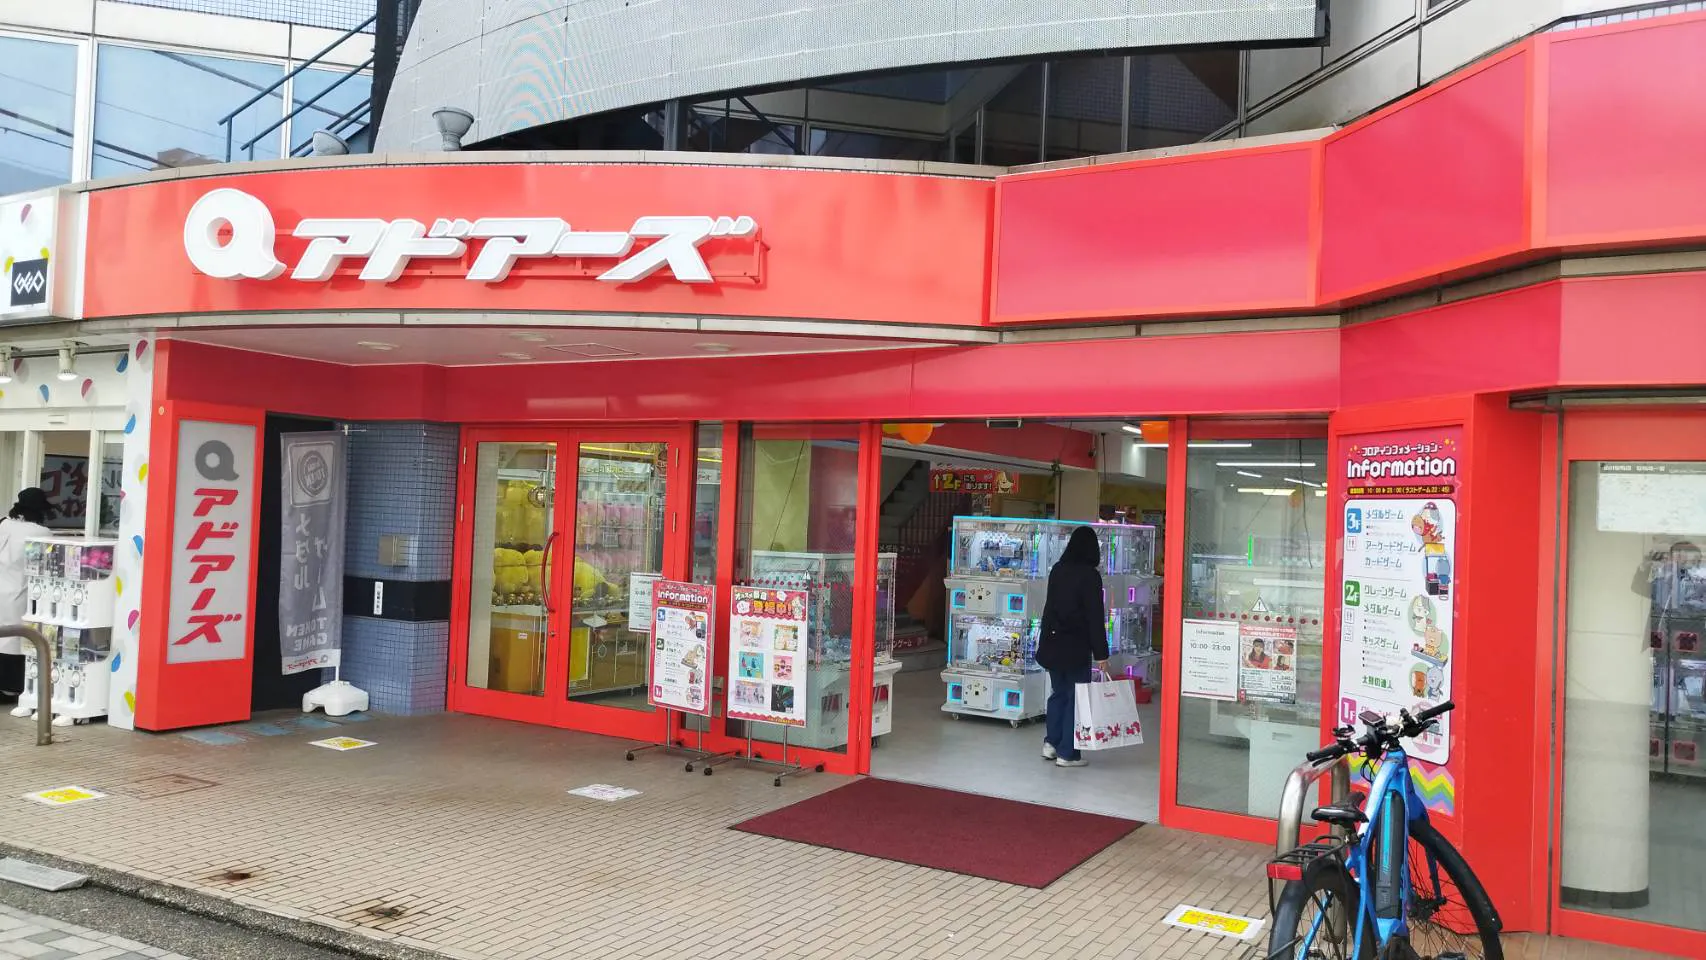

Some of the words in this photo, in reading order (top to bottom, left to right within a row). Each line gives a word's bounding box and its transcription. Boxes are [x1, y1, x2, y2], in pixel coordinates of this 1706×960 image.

[290, 215, 757, 283] アドアーズ
[13, 270, 45, 295] GEO
[1346, 456, 1456, 478] Information
[172, 488, 242, 645] アドアーズ
